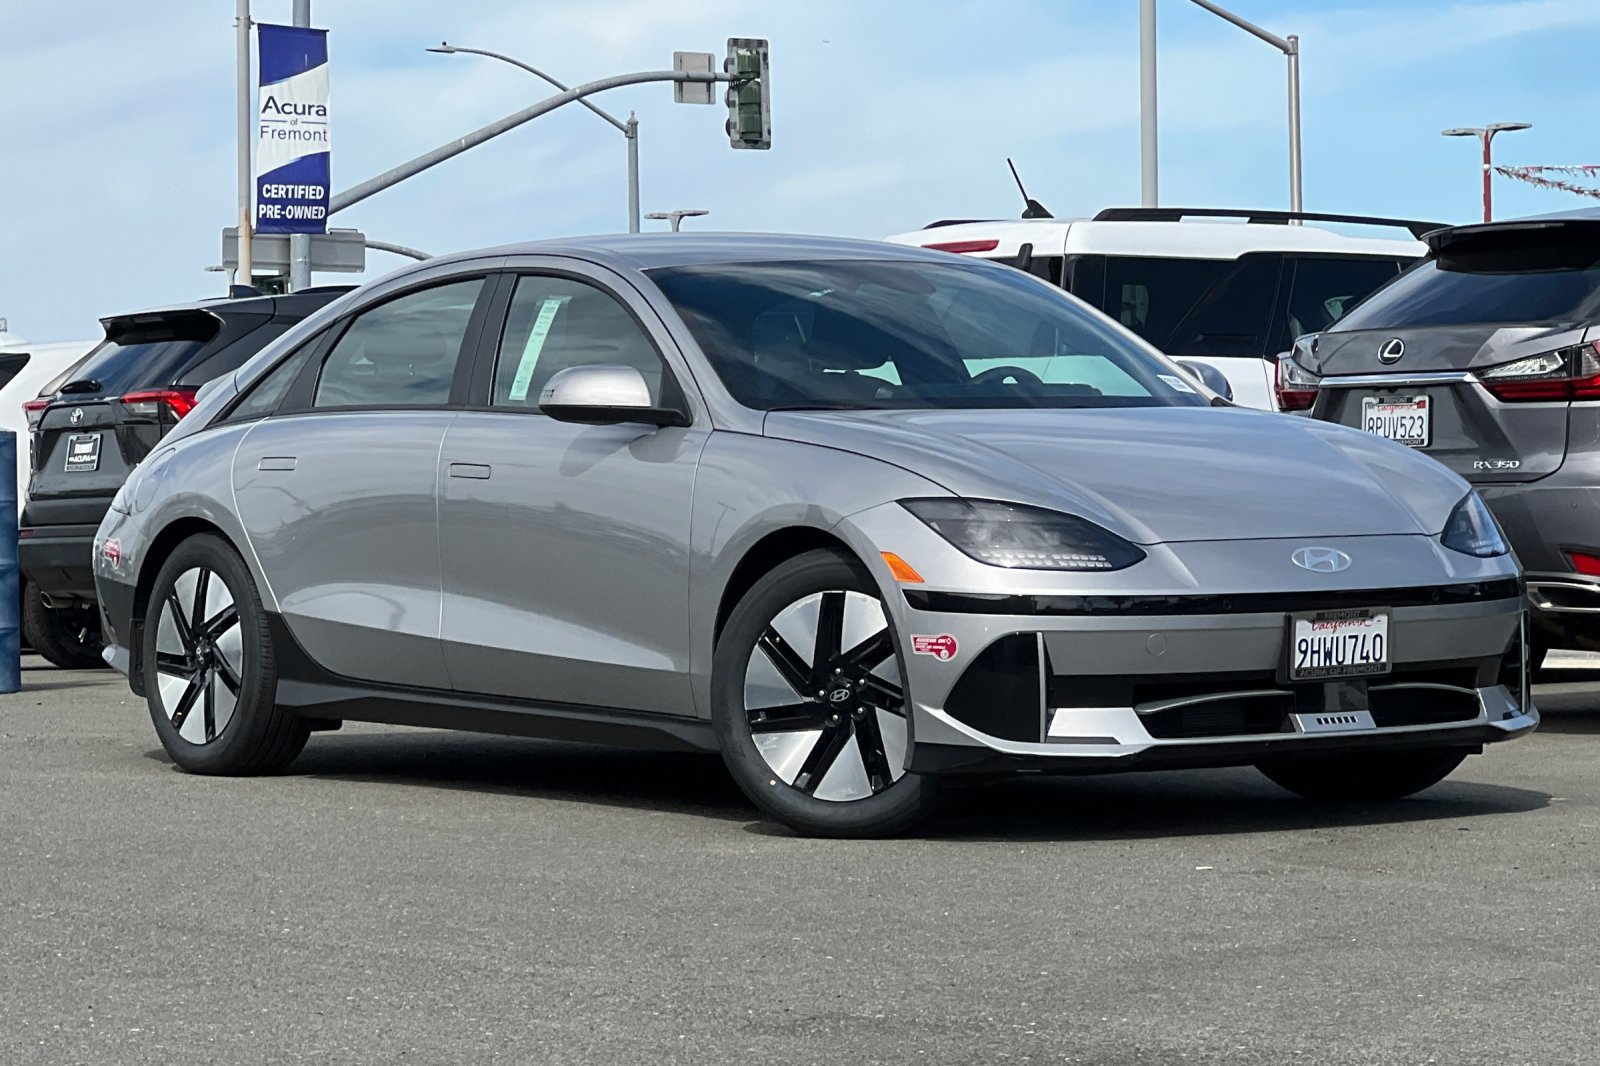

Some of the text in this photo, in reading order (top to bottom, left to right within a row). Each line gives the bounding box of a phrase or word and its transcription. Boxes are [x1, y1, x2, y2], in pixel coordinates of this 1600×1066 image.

[261, 96, 327, 117] Acura
[290, 118, 298, 126] of
[260, 125, 327, 142] Fremont
[262, 184, 325, 200] CERTIFIED
[258, 204, 326, 220] PRE-OWNED
[1367, 415, 1424, 439] 8PUV523
[1297, 633, 1384, 669] 9HWU740
